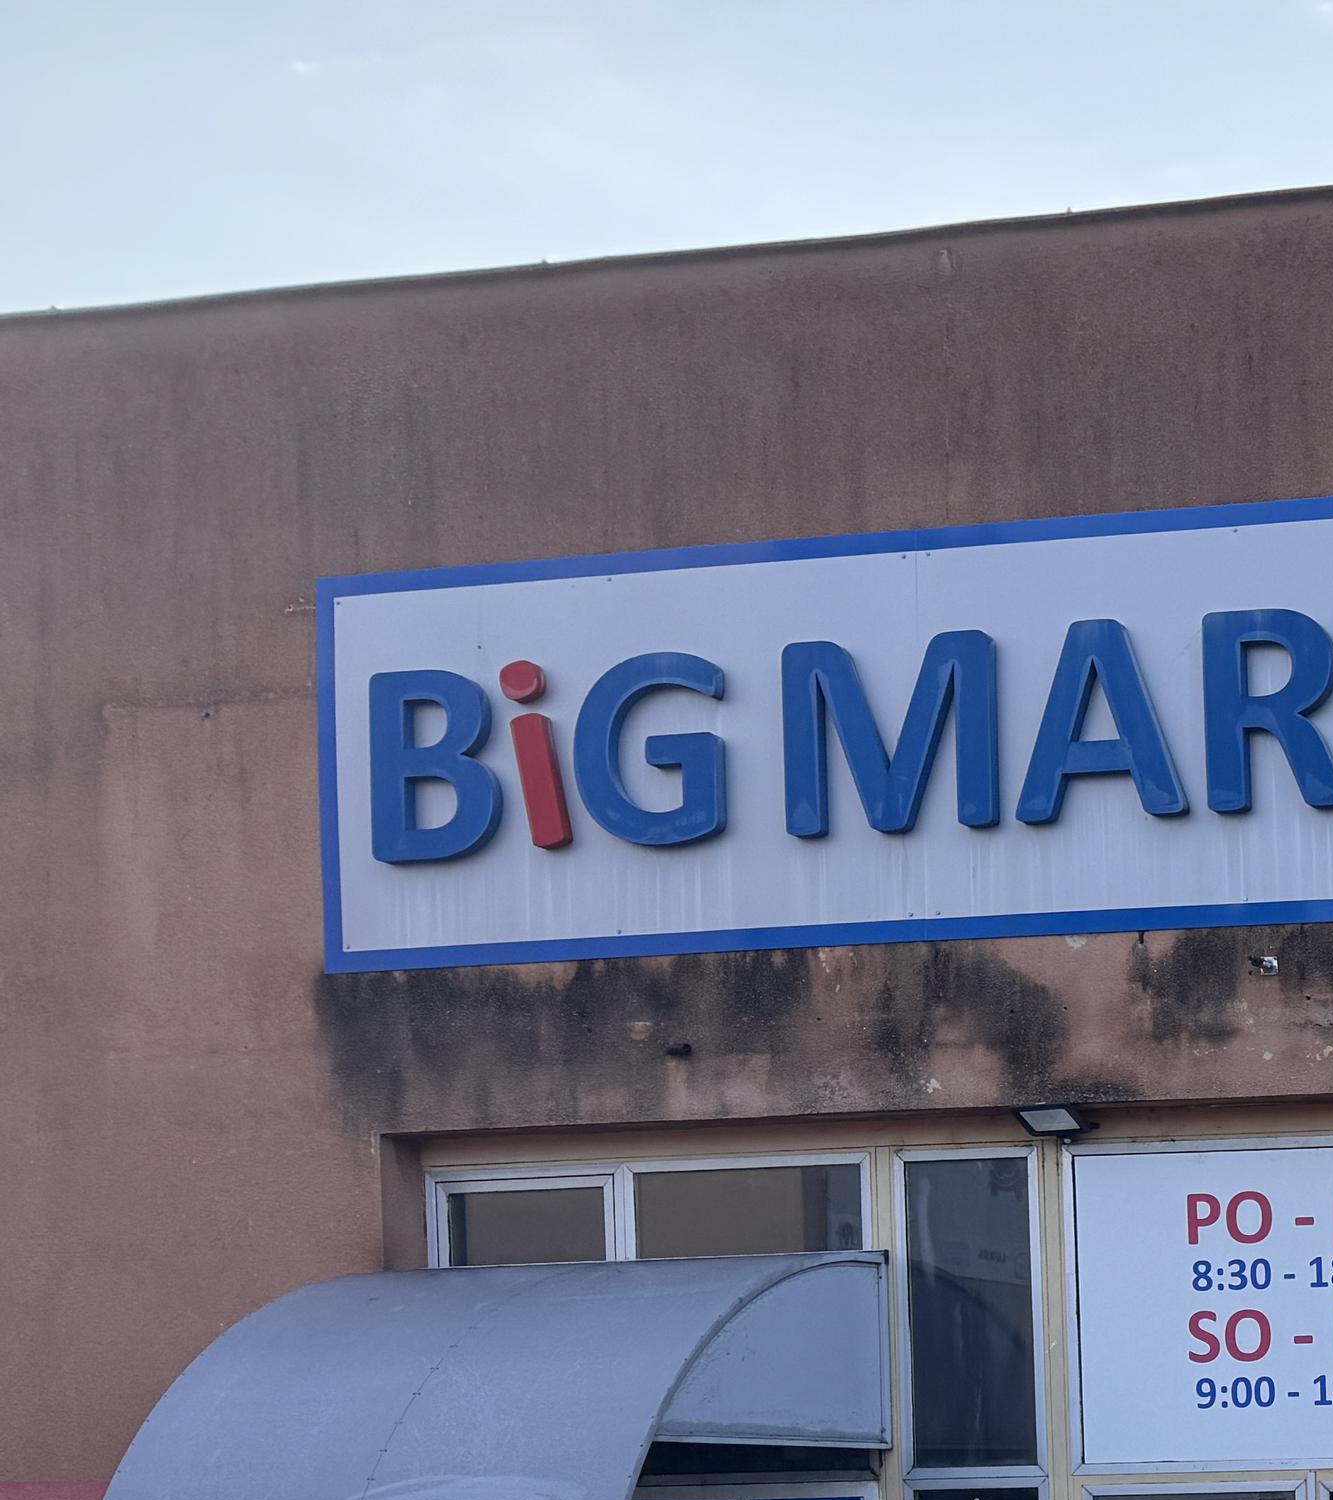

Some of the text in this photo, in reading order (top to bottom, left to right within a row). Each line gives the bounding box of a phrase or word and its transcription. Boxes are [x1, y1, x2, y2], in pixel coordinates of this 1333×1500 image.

[368, 651, 727, 864] BiG
[1186, 1190, 1273, 1245] PO
[1191, 1257, 1272, 1292] 8:30
[1187, 1308, 1272, 1364] SO
[1195, 1376, 1276, 1410] 9:00
